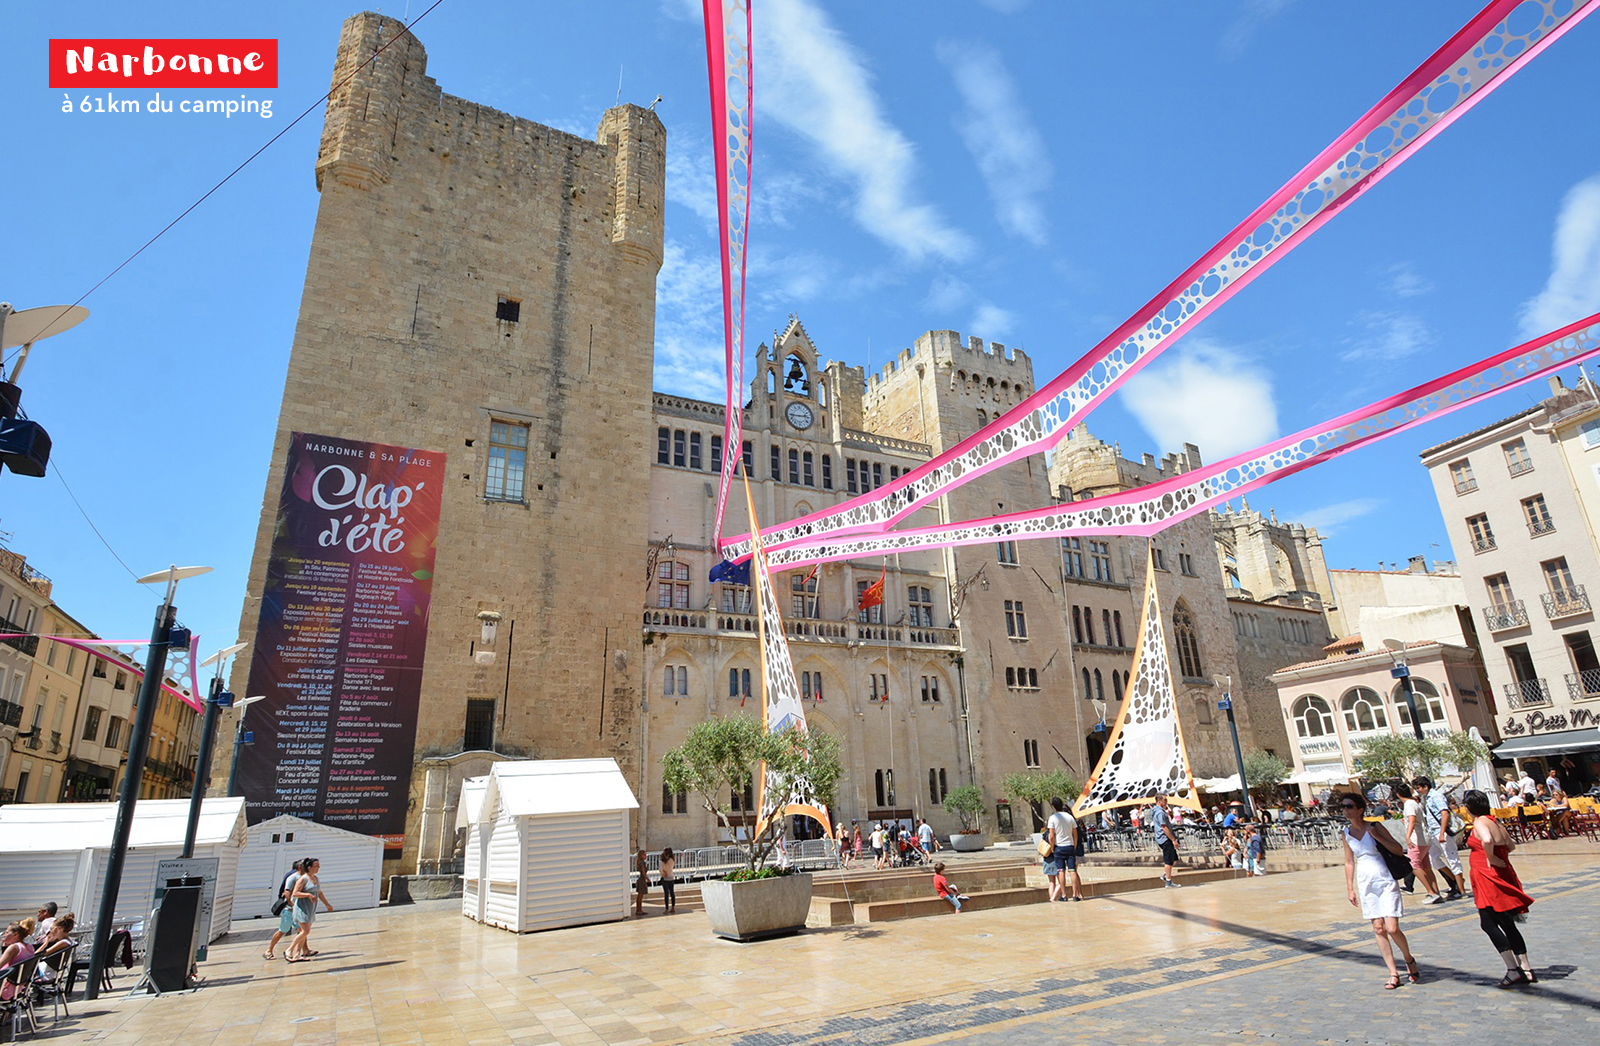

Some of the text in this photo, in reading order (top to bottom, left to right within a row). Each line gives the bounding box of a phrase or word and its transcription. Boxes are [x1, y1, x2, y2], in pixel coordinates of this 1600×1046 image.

[306, 442, 364, 458] NARBONNE
[381, 453, 394, 462] SA
[400, 456, 432, 468] PLAGE
[312, 464, 425, 519] Clap'
[318, 513, 405, 554] d'été
[1503, 716, 1525, 736] Le
[1526, 710, 1568, 736] Petit
